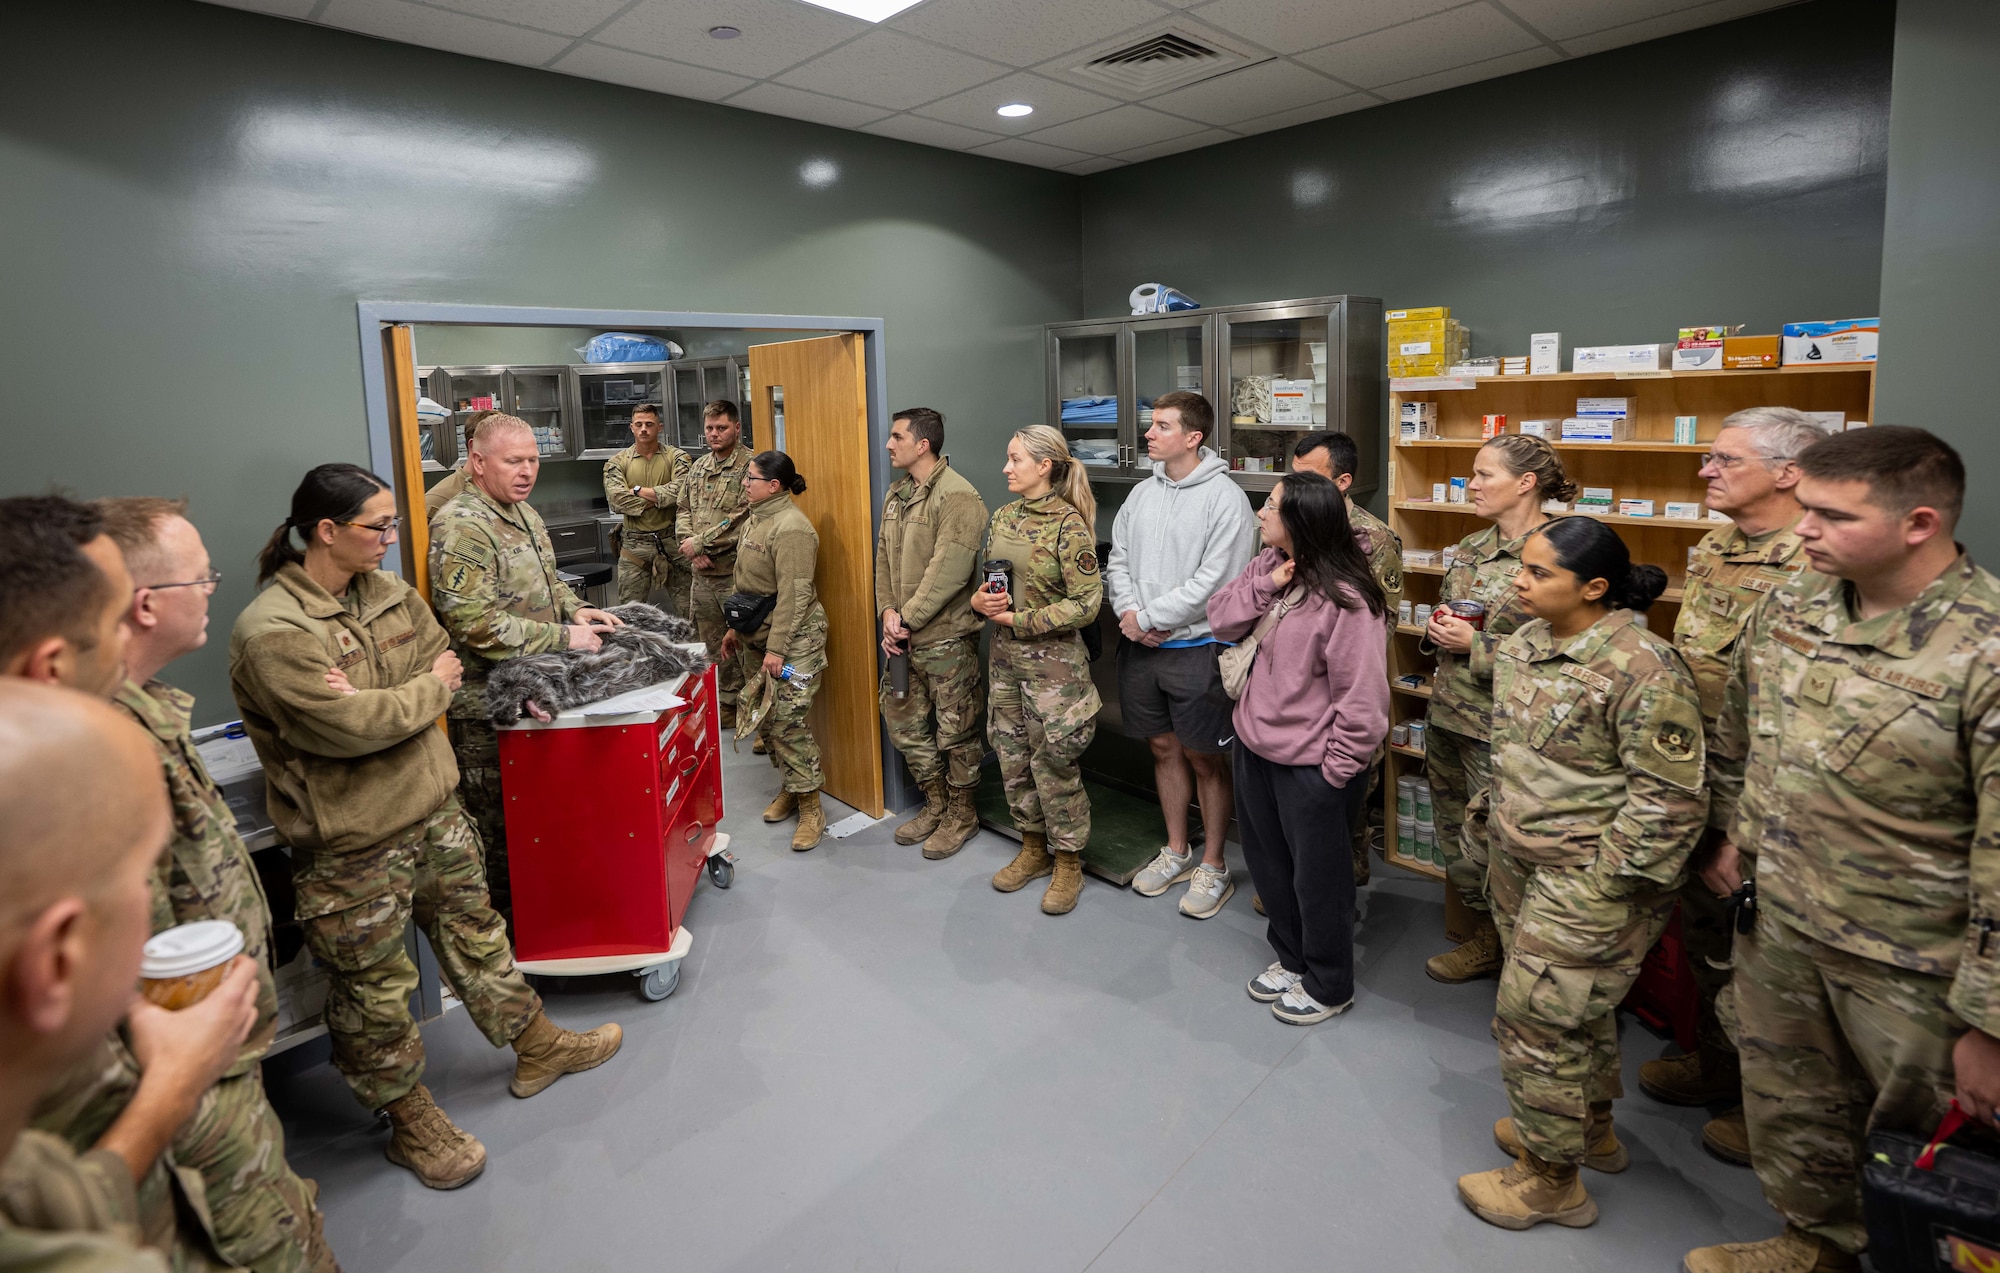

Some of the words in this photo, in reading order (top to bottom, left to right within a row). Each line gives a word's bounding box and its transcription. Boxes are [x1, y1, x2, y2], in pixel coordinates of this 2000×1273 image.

[1581, 671, 1611, 691] FORCE
[1885, 671, 1903, 683] AIR
[1904, 676, 1944, 697] FORCE
